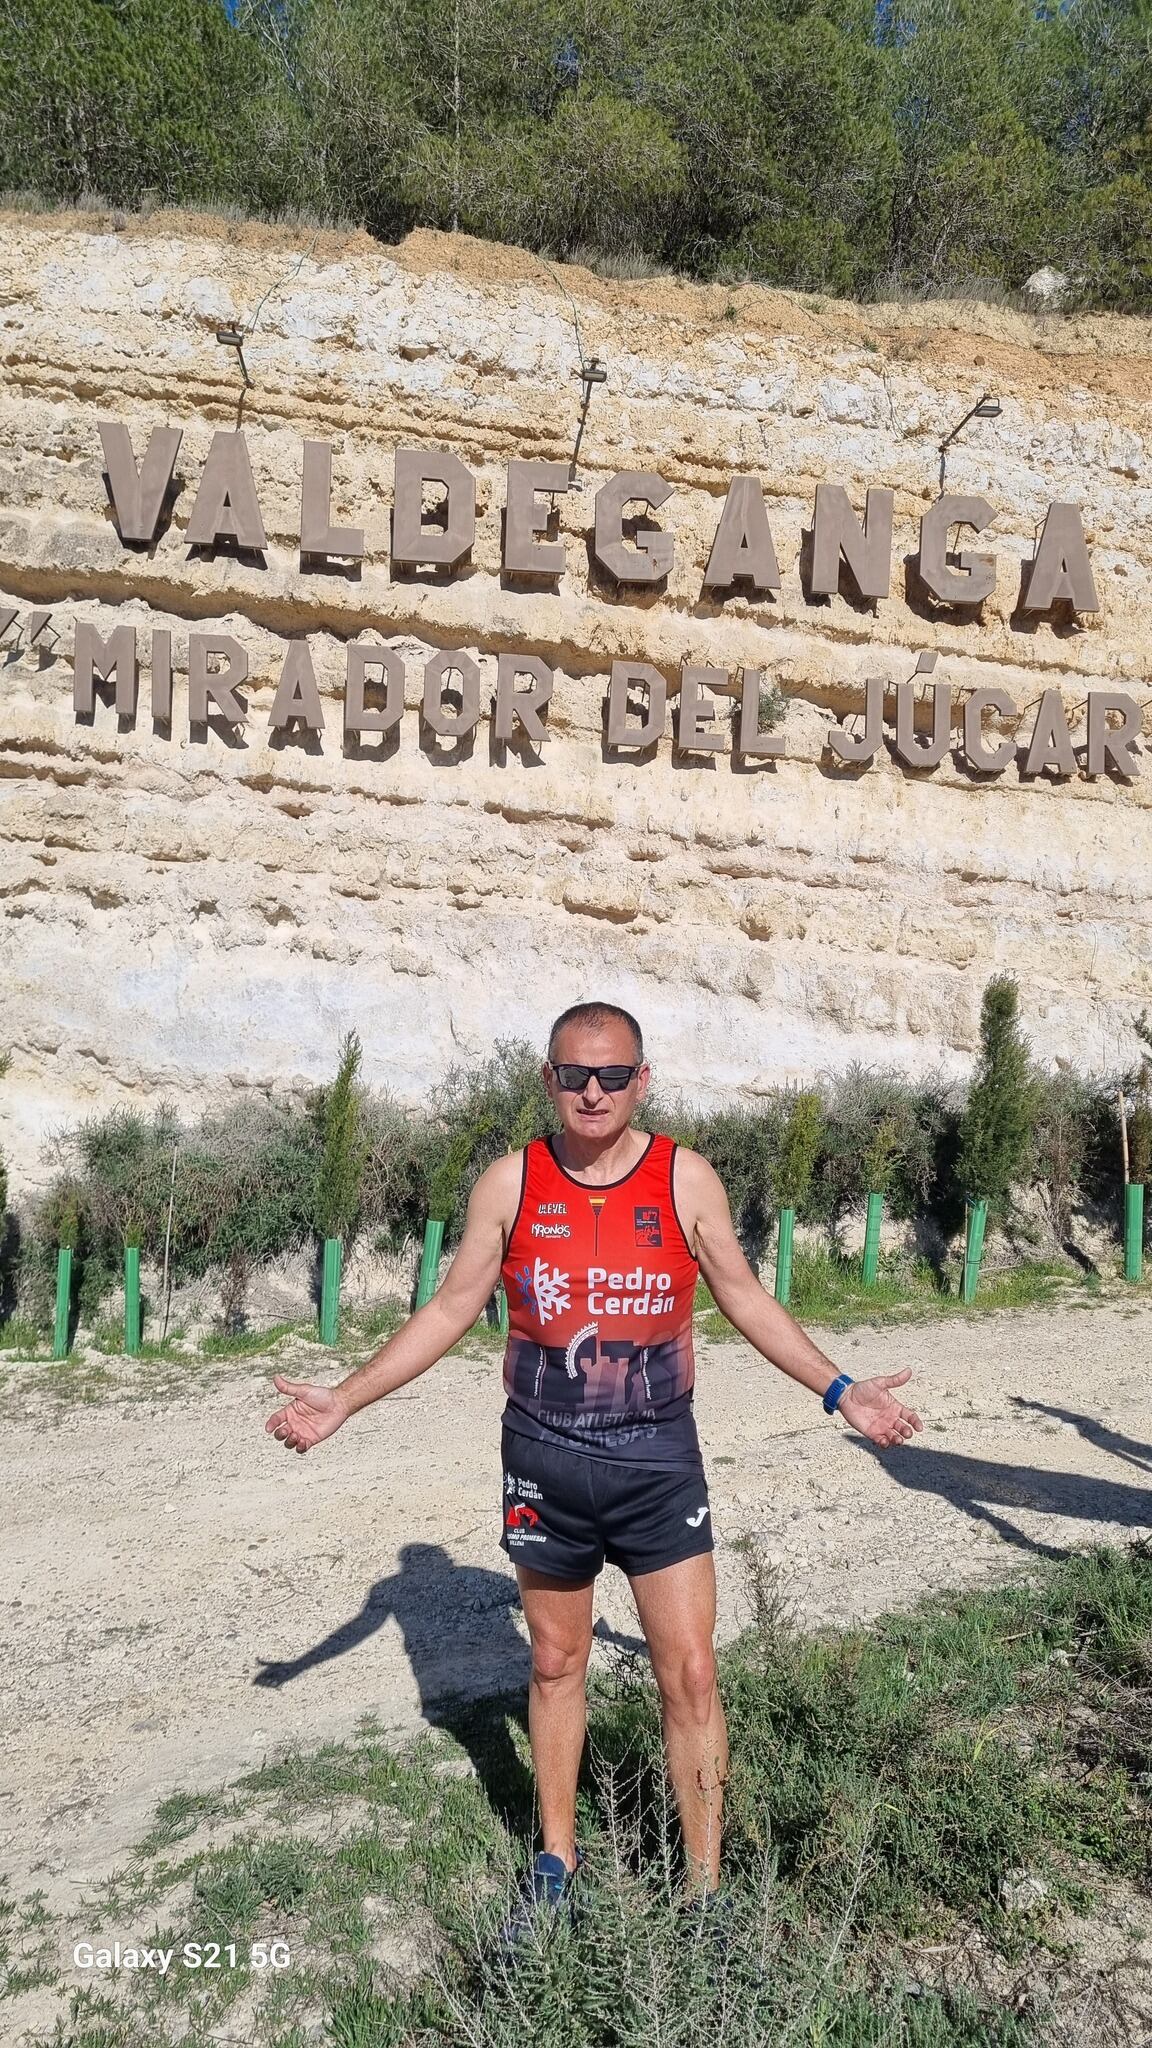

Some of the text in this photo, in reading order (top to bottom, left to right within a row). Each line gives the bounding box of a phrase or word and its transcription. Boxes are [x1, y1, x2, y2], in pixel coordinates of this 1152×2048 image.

[98, 422, 1100, 613] VALDEGANGA
[607, 660, 786, 756] DEL
[827, 651, 1144, 776] JÚCAR
[587, 1266, 672, 1291] Pedro
[587, 1292, 675, 1316] Cerdán
[537, 1409, 573, 1428] CLUB
[517, 1477, 538, 1490] Pedro
[517, 1486, 544, 1500] Cerdán
